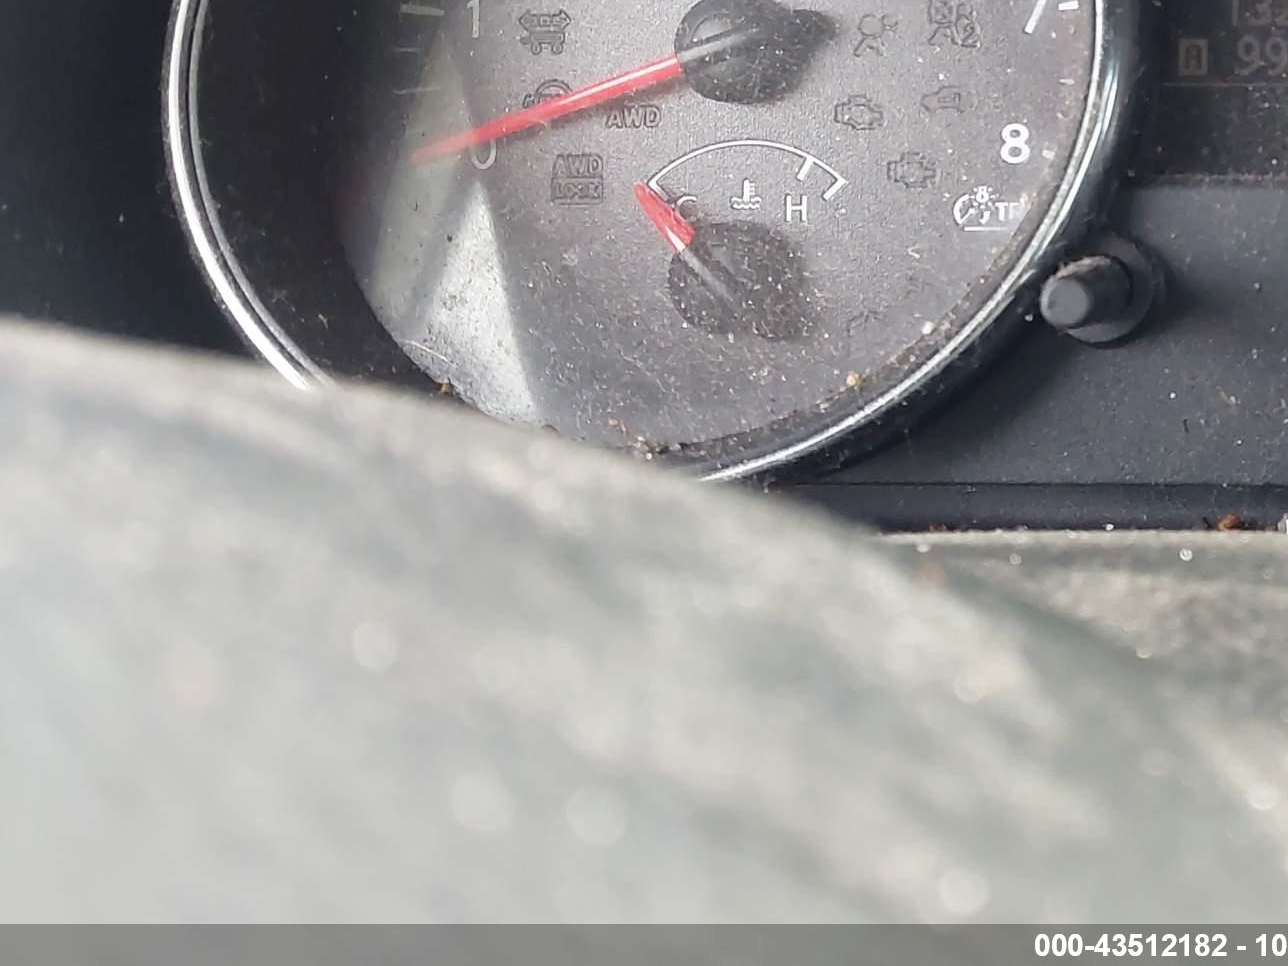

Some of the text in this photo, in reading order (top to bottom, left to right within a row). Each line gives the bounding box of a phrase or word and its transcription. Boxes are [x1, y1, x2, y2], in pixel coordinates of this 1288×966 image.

[604, 104, 661, 129] AWD
[1000, 122, 1031, 165] 8
[785, 195, 808, 222] H
